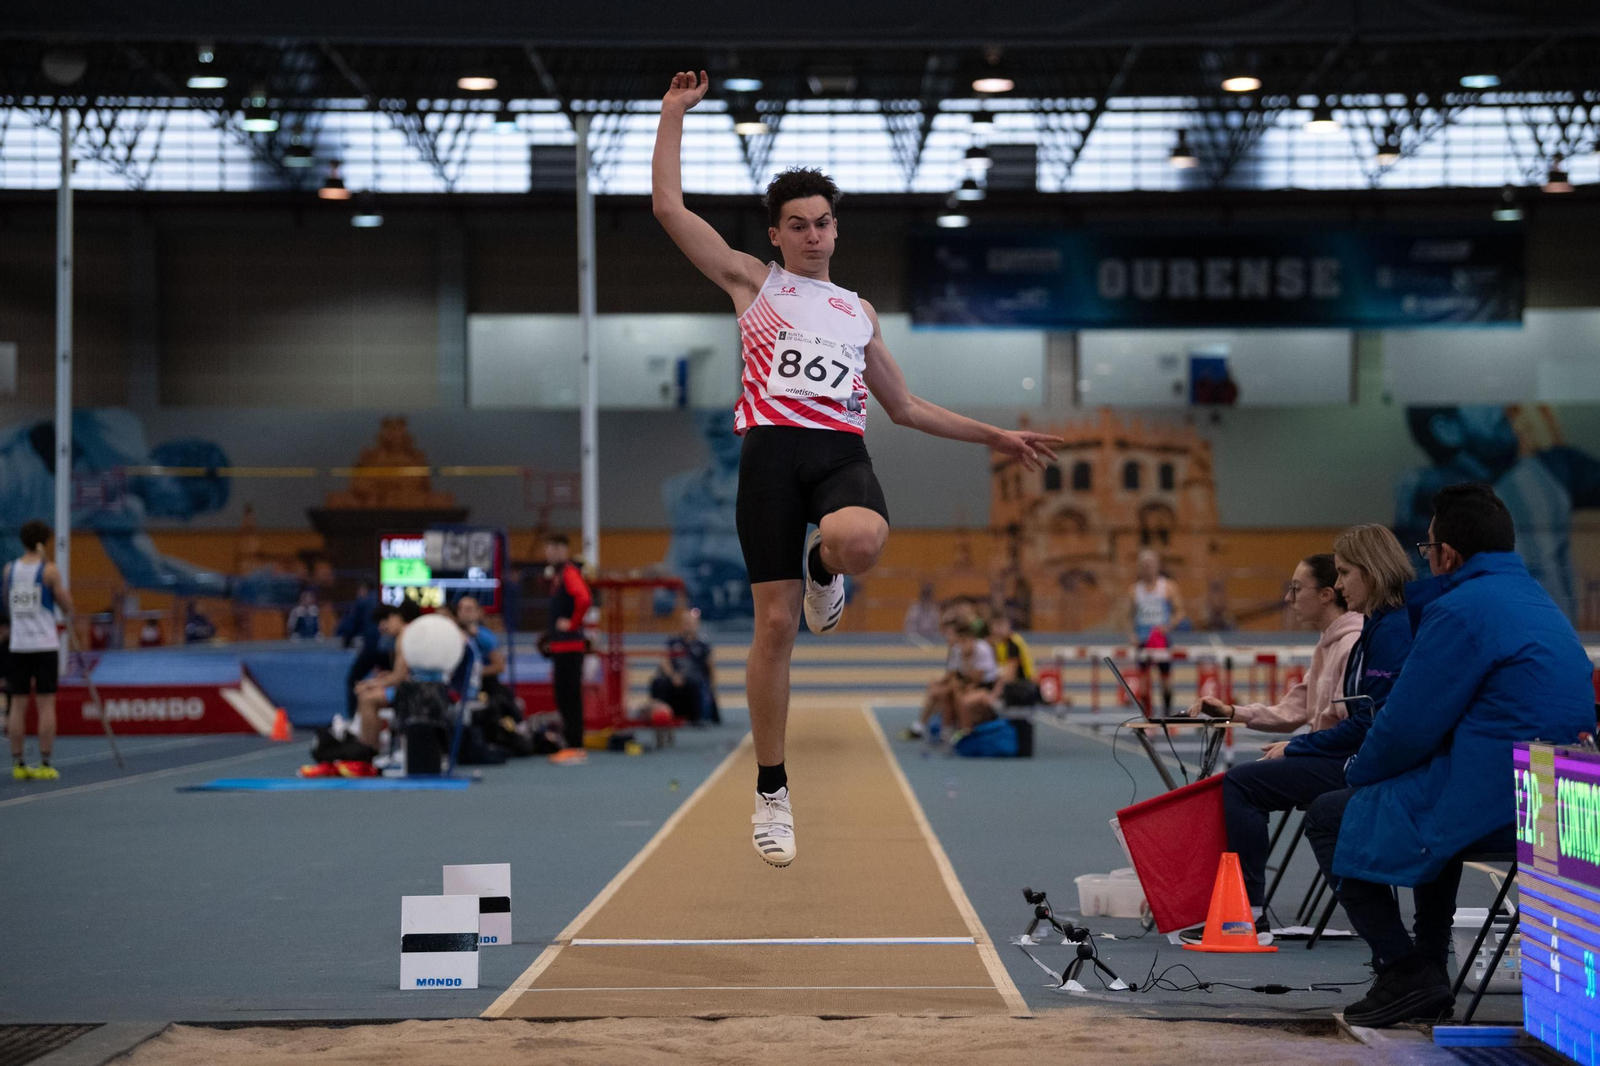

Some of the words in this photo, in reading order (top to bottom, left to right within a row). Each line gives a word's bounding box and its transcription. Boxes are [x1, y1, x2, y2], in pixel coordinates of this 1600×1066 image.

[1097, 257, 1342, 298] OURENSE
[778, 349, 850, 389] 867
[785, 387, 819, 397] atletismo
[105, 697, 205, 721] MONDO
[1558, 776, 1600, 867] CONTRO
[416, 978, 462, 987] MONDO
